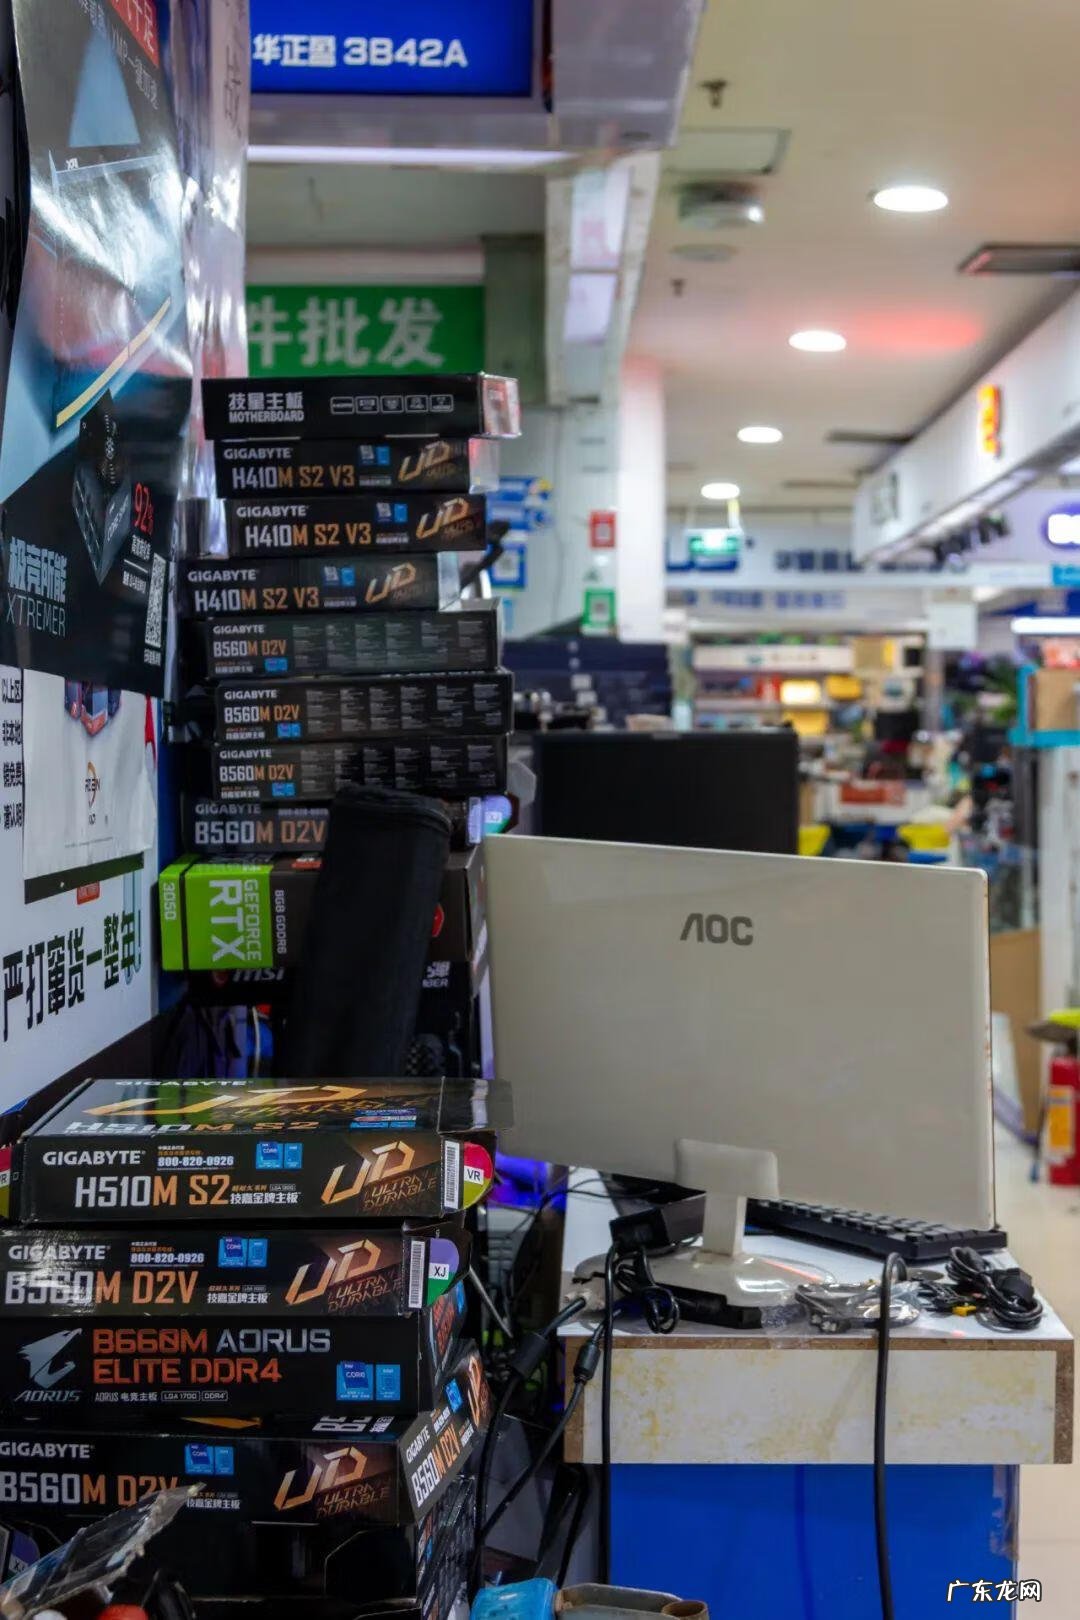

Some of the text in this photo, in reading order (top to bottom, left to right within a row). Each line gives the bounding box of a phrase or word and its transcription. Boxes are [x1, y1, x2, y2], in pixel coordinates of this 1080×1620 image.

[343, 36, 469, 68] 3B42A
[229, 411, 304, 423] MOTHERBOARD
[224, 447, 291, 459] GIGABYTE
[232, 467, 293, 488] H410M
[300, 466, 324, 487] S2
[330, 465, 354, 486] V3
[236, 505, 306, 518] GIGABYTE
[246, 525, 308, 548] H410M
[314, 524, 340, 546] S2
[346, 523, 371, 544] V3
[187, 569, 256, 582] GIGABYTE
[195, 589, 256, 612] H410M
[263, 588, 288, 610] S2
[294, 586, 319, 608] V3
[6, 593, 66, 638] XTREMER
[213, 624, 264, 635] GIGABYTE
[213, 639, 286, 658] B560M D2V
[224, 689, 277, 700] GIGABYTE
[224, 704, 300, 724] B560M D2V
[219, 749, 272, 760] GIGABYTE
[219, 763, 294, 782] B560M D2V
[195, 803, 261, 815] GIGABYTE
[194, 819, 328, 845] B560M D2V
[163, 882, 177, 921] 3050
[209, 879, 245, 963] RTX
[244, 879, 262, 961] GEFORCE
[274, 889, 287, 954] 8GB GDDR6
[680, 913, 754, 946] AOC
[42, 1150, 142, 1166] GIGABYTE
[371, 1174, 421, 1197] ULTRA
[467, 1169, 481, 1181] VR
[75, 1174, 231, 1208] H510M S2
[230, 1192, 299, 1205] 技嘉金牌主板
[364, 1176, 438, 1208] DURABLE
[8, 1245, 106, 1260] GIGABYTE
[434, 1266, 447, 1278] XJ
[5, 1270, 199, 1305] B560M D2V
[336, 1273, 386, 1298] ULTRA
[93, 1328, 331, 1354] B660M AORUS
[93, 1357, 282, 1384] ELITE DDR4
[14, 1390, 82, 1402] AORUS
[95, 1392, 119, 1402] AORUS
[121, 1392, 158, 1402] 电竞主板
[164, 1392, 179, 1400] LGA
[179, 1392, 198, 1400] 1700
[0, 1442, 91, 1459] GIGABYTE
[406, 1424, 431, 1464] GIGABYTE
[0, 1471, 106, 1505] B560M
[411, 1450, 446, 1508] B560M
[323, 1483, 375, 1507] ULTRA
